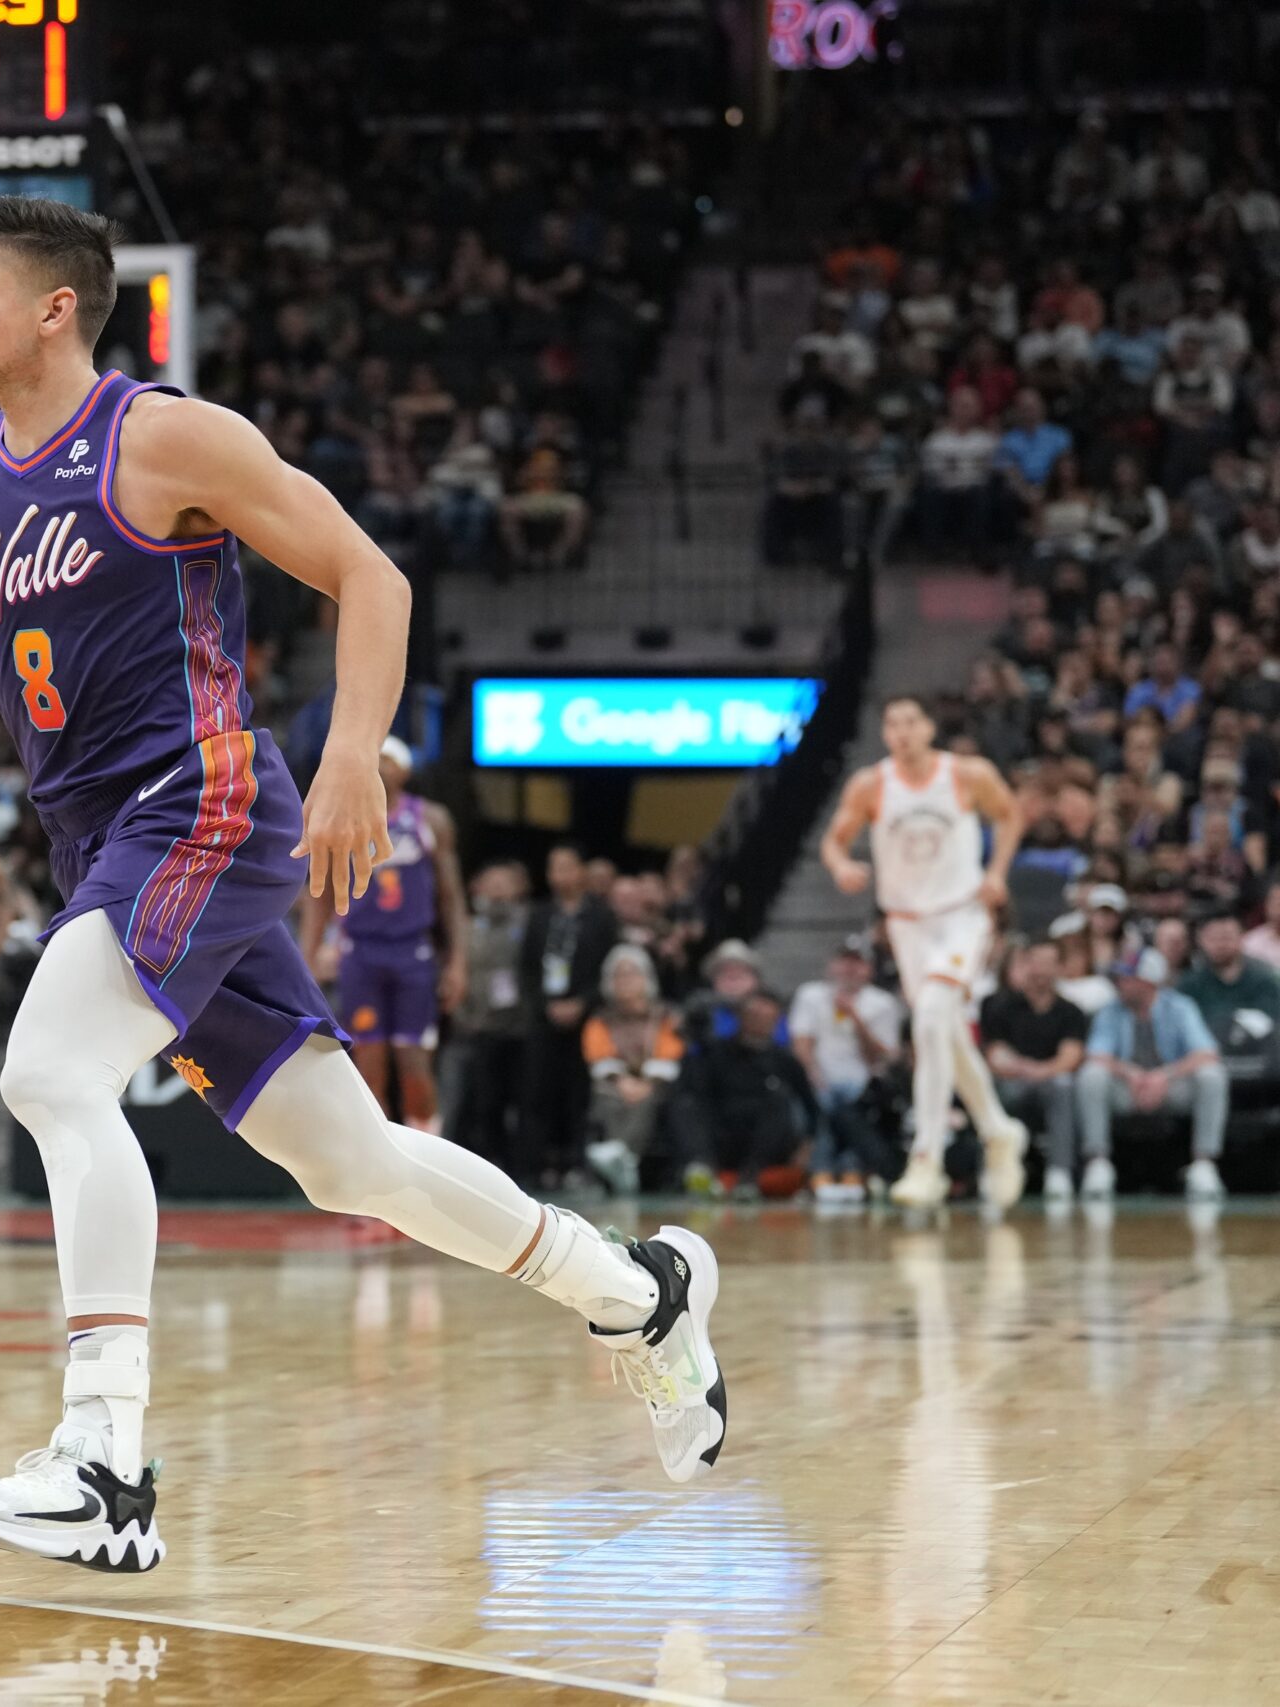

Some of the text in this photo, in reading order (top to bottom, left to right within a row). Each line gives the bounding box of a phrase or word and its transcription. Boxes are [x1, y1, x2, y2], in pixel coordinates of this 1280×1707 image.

[54, 463, 97, 480] PayPal
[12, 627, 67, 732] 8
[560, 696, 713, 756] Google
